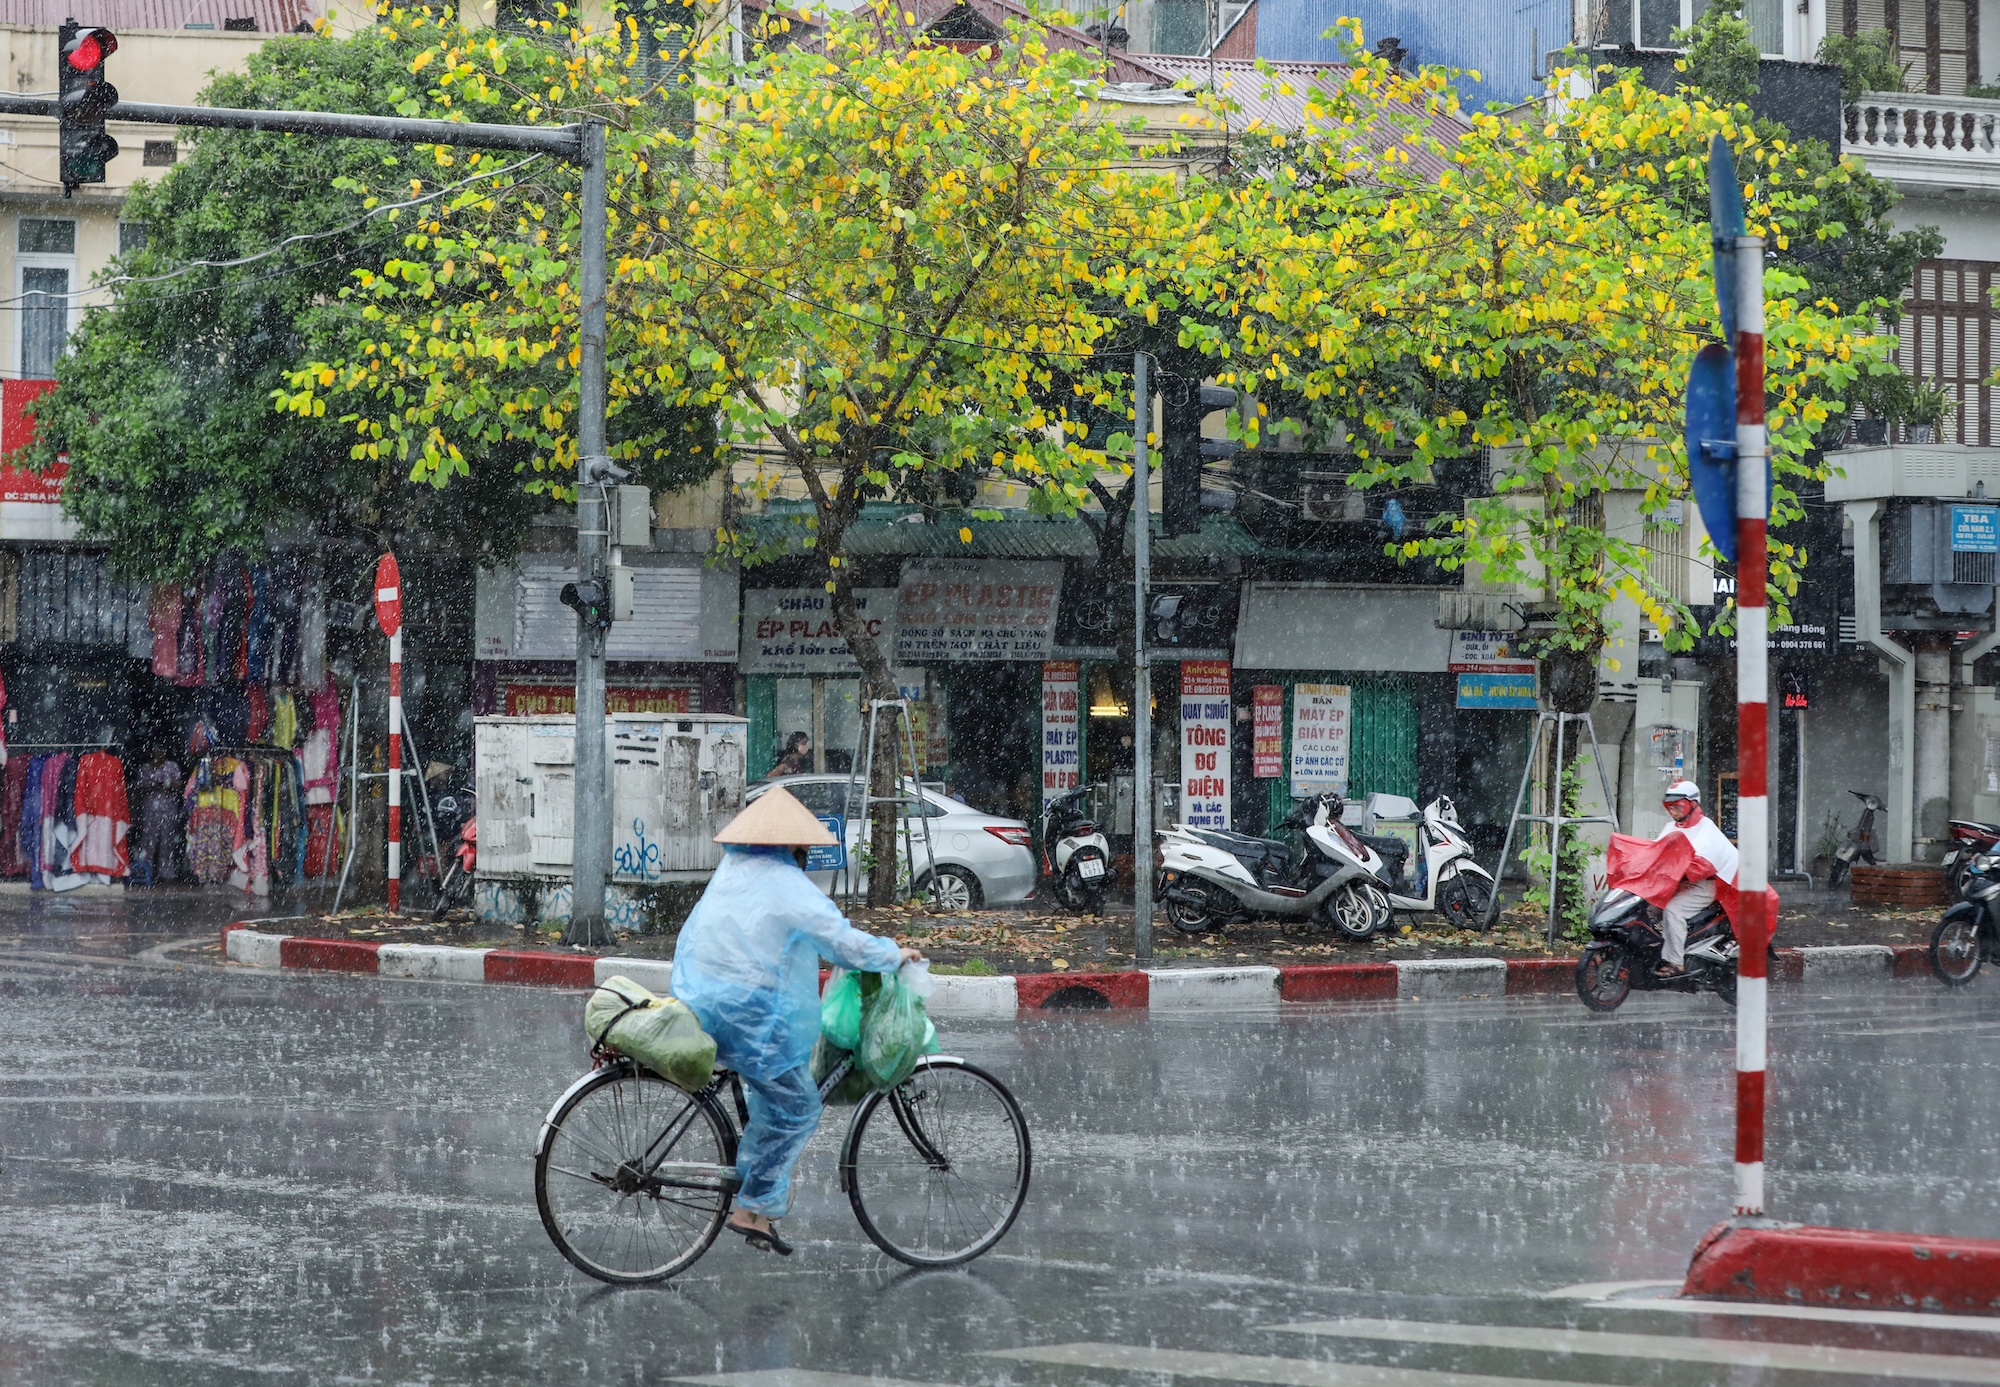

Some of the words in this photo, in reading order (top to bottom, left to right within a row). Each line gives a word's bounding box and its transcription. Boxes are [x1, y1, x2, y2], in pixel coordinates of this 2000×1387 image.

[1962, 513, 1989, 524] TBA
[756, 617, 785, 638] ÉP
[1182, 703, 1202, 720] QUAY
[1185, 724, 1226, 746] TÔNG
[1044, 750, 1078, 765] PLASTIC
[1195, 751, 1217, 771] ĐƠ
[1187, 775, 1225, 799] ĐIỆN
